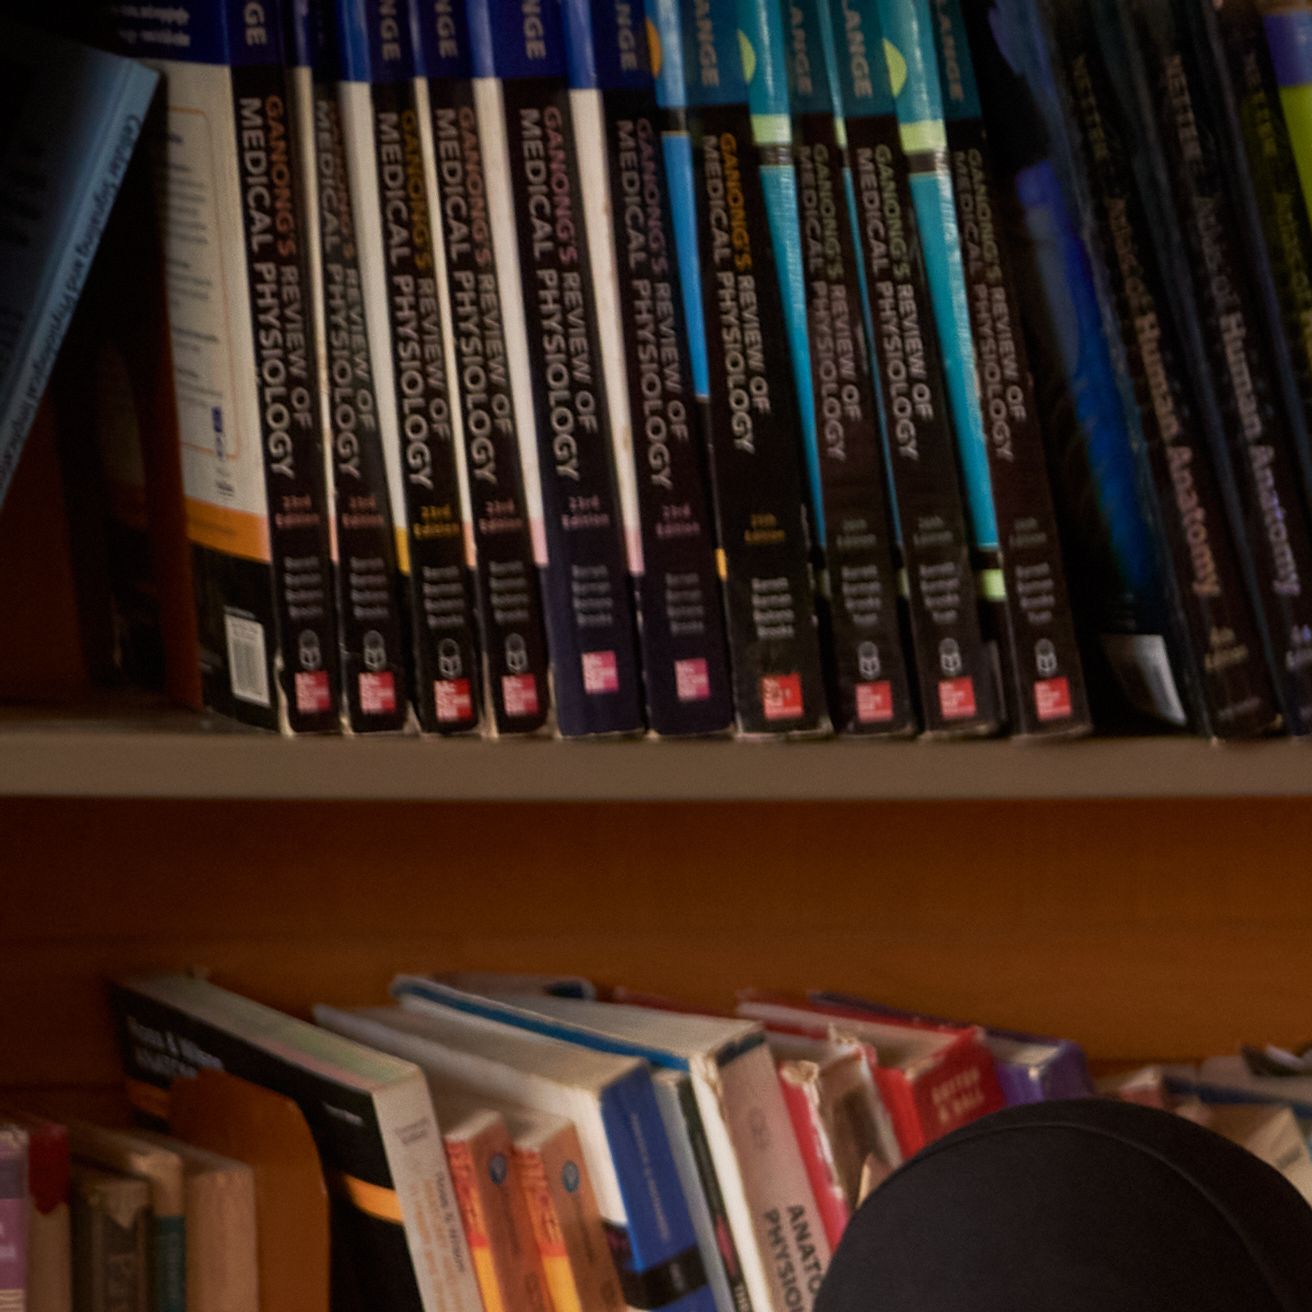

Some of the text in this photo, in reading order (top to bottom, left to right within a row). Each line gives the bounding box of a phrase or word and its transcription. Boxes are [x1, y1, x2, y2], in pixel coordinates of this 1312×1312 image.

[239, 97, 296, 480] MEDICAL PHYSIOLOGY
[265, 95, 313, 431] GANONG'S REVIEW OF
[315, 100, 361, 480] MEDICAL PHYSIOLOGY
[378, 112, 433, 490] MEDICAL PHYSIOLOGY
[401, 110, 449, 441] GANONG'S REVIEW OF
[435, 108, 497, 484] MEDICAL PHYSIOLOGY
[458, 107, 513, 435] GANONG'S REVIEW OF
[519, 108, 580, 482] MEDICAL PHYSIOLOGY
[543, 106, 598, 434] GANONG'S REVIEW OF
[616, 120, 673, 490] MEDICAL PHYSIOLOGY
[655, 283, 682, 394] REVIEW
[667, 400, 689, 444] OF
[703, 135, 754, 455] MEDICAL PHYSIOLOGY
[720, 133, 771, 414] GANONG'S REVIEW OF
[800, 145, 847, 463] MEDICAL PHYSIOLOGY
[831, 284, 855, 382] REVIEW
[841, 384, 862, 422] OF
[857, 147, 919, 462] MEDICAL PHYSIOLOGY
[875, 144, 934, 421] GANONG'S REVIEW OF
[954, 151, 1014, 463] MEDICAL PHYSIOLOGY
[990, 287, 1019, 381] REVIEW
[1007, 384, 1027, 422] OF
[1166, 447, 1223, 597] Anatomy
[1249, 445, 1301, 596] Anatomy
